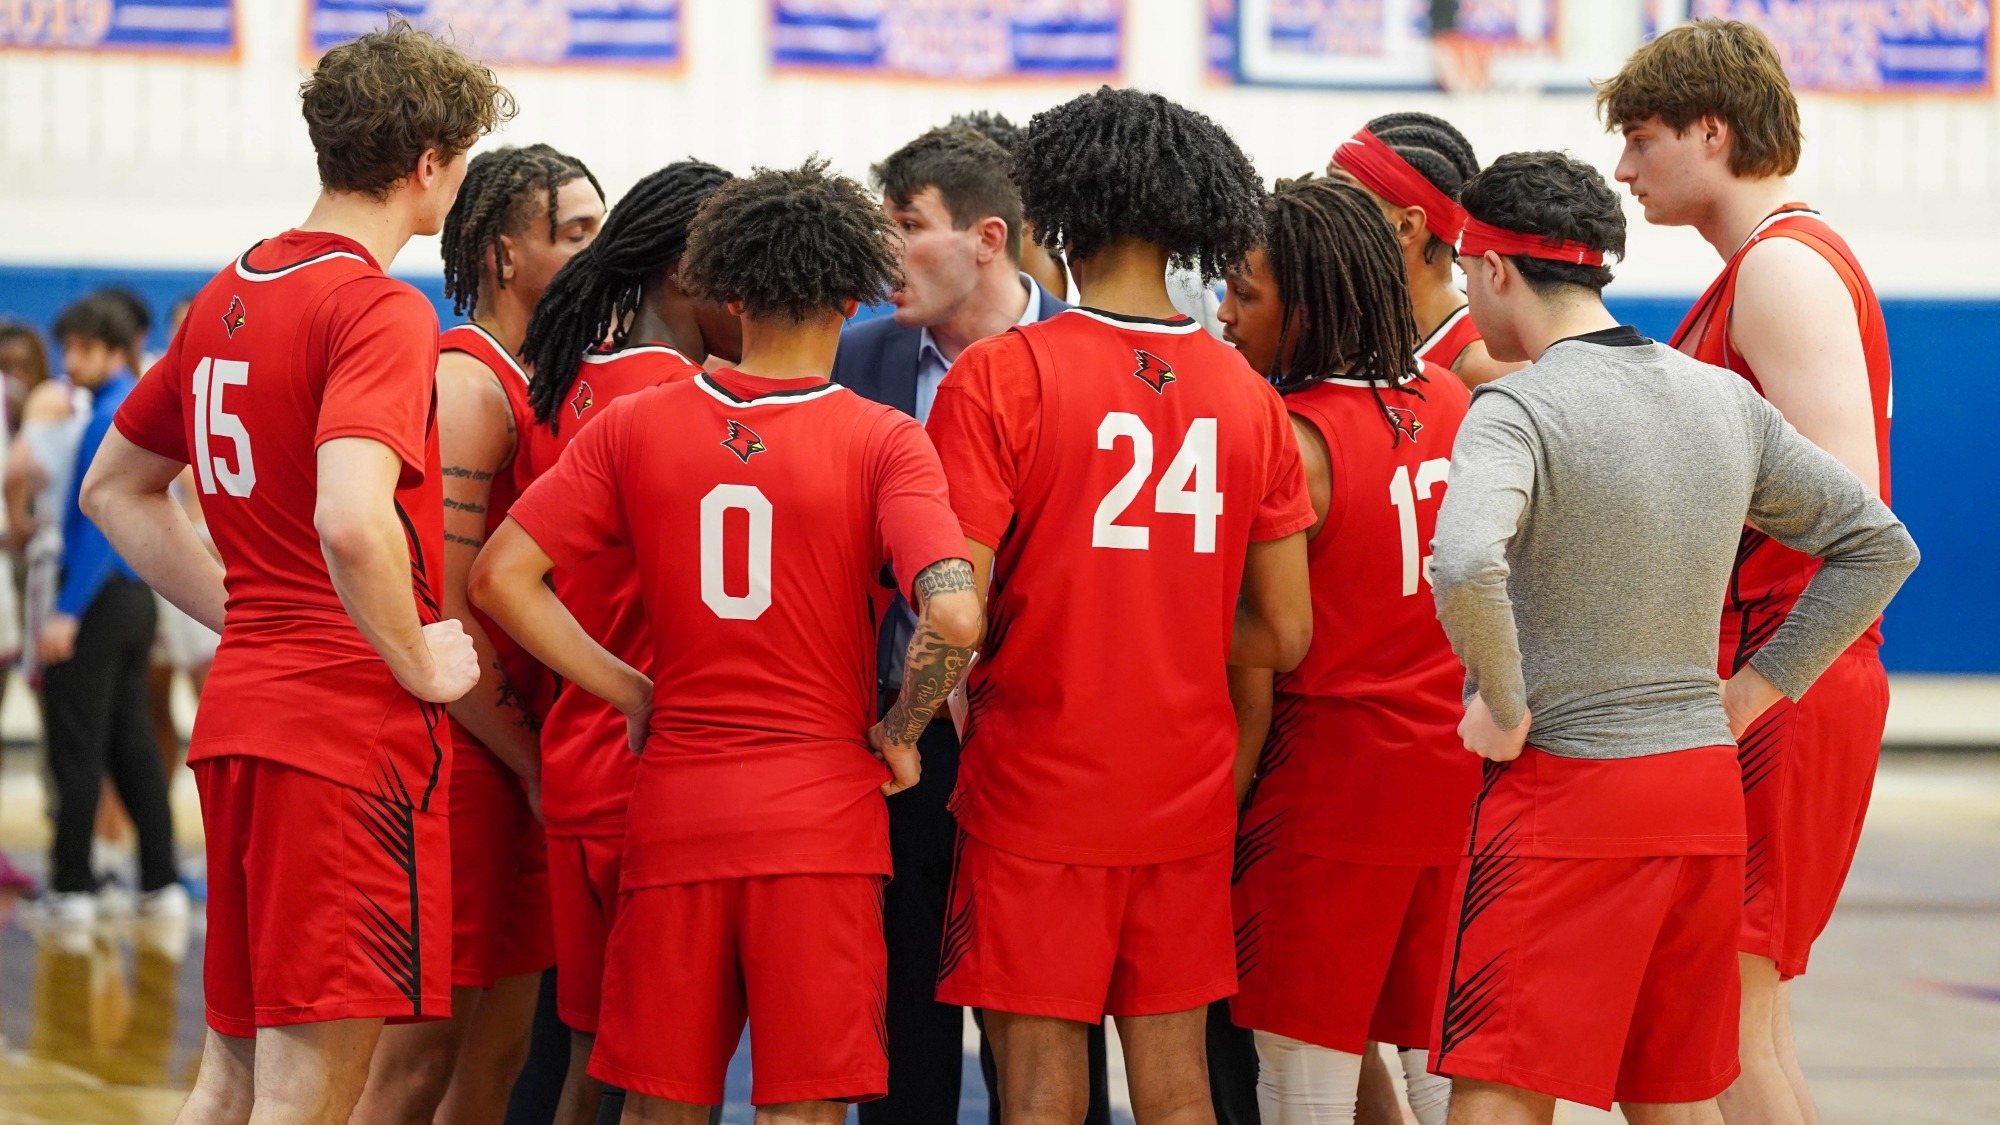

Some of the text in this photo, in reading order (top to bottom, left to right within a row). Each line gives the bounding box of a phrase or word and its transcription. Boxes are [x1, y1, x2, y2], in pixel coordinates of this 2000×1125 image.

[192, 356, 257, 499] 15
[1091, 411, 1224, 554] 24
[700, 483, 773, 621] 0
[916, 677, 938, 704] The
